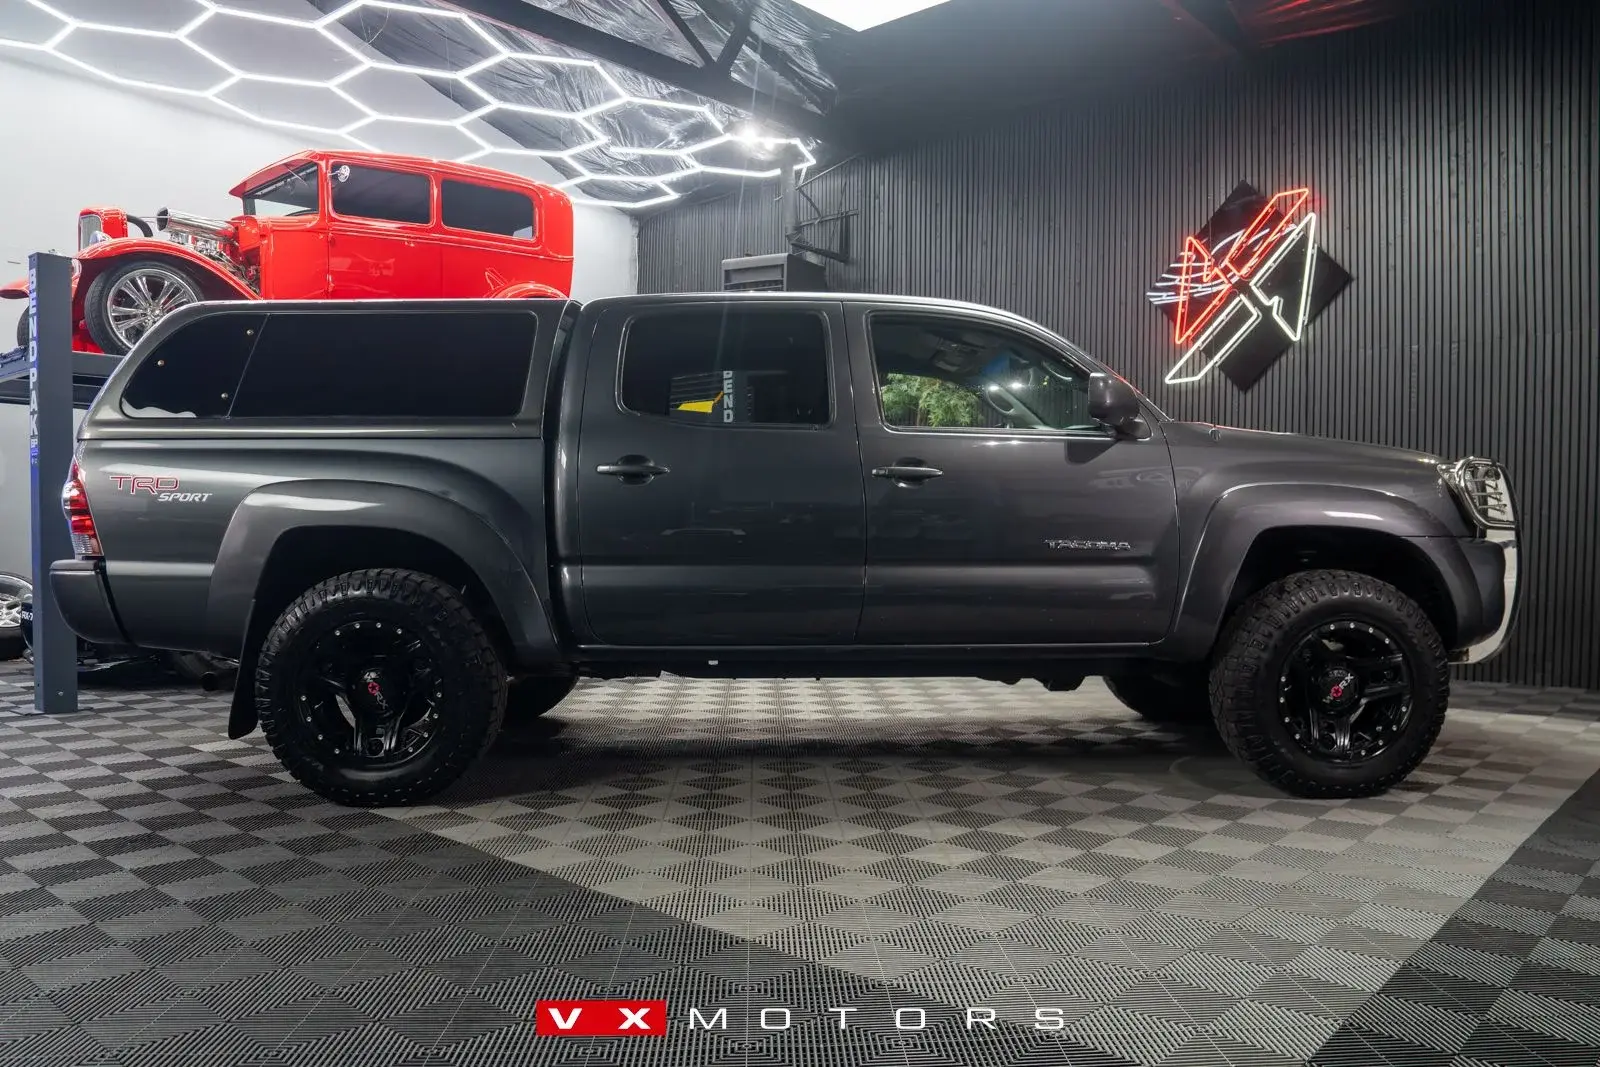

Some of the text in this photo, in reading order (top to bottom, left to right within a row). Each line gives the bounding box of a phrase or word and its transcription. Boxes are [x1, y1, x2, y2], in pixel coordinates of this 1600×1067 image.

[110, 475, 180, 495] TRD
[157, 492, 213, 502] SPORT
[1043, 539, 1131, 551] TACOMA
